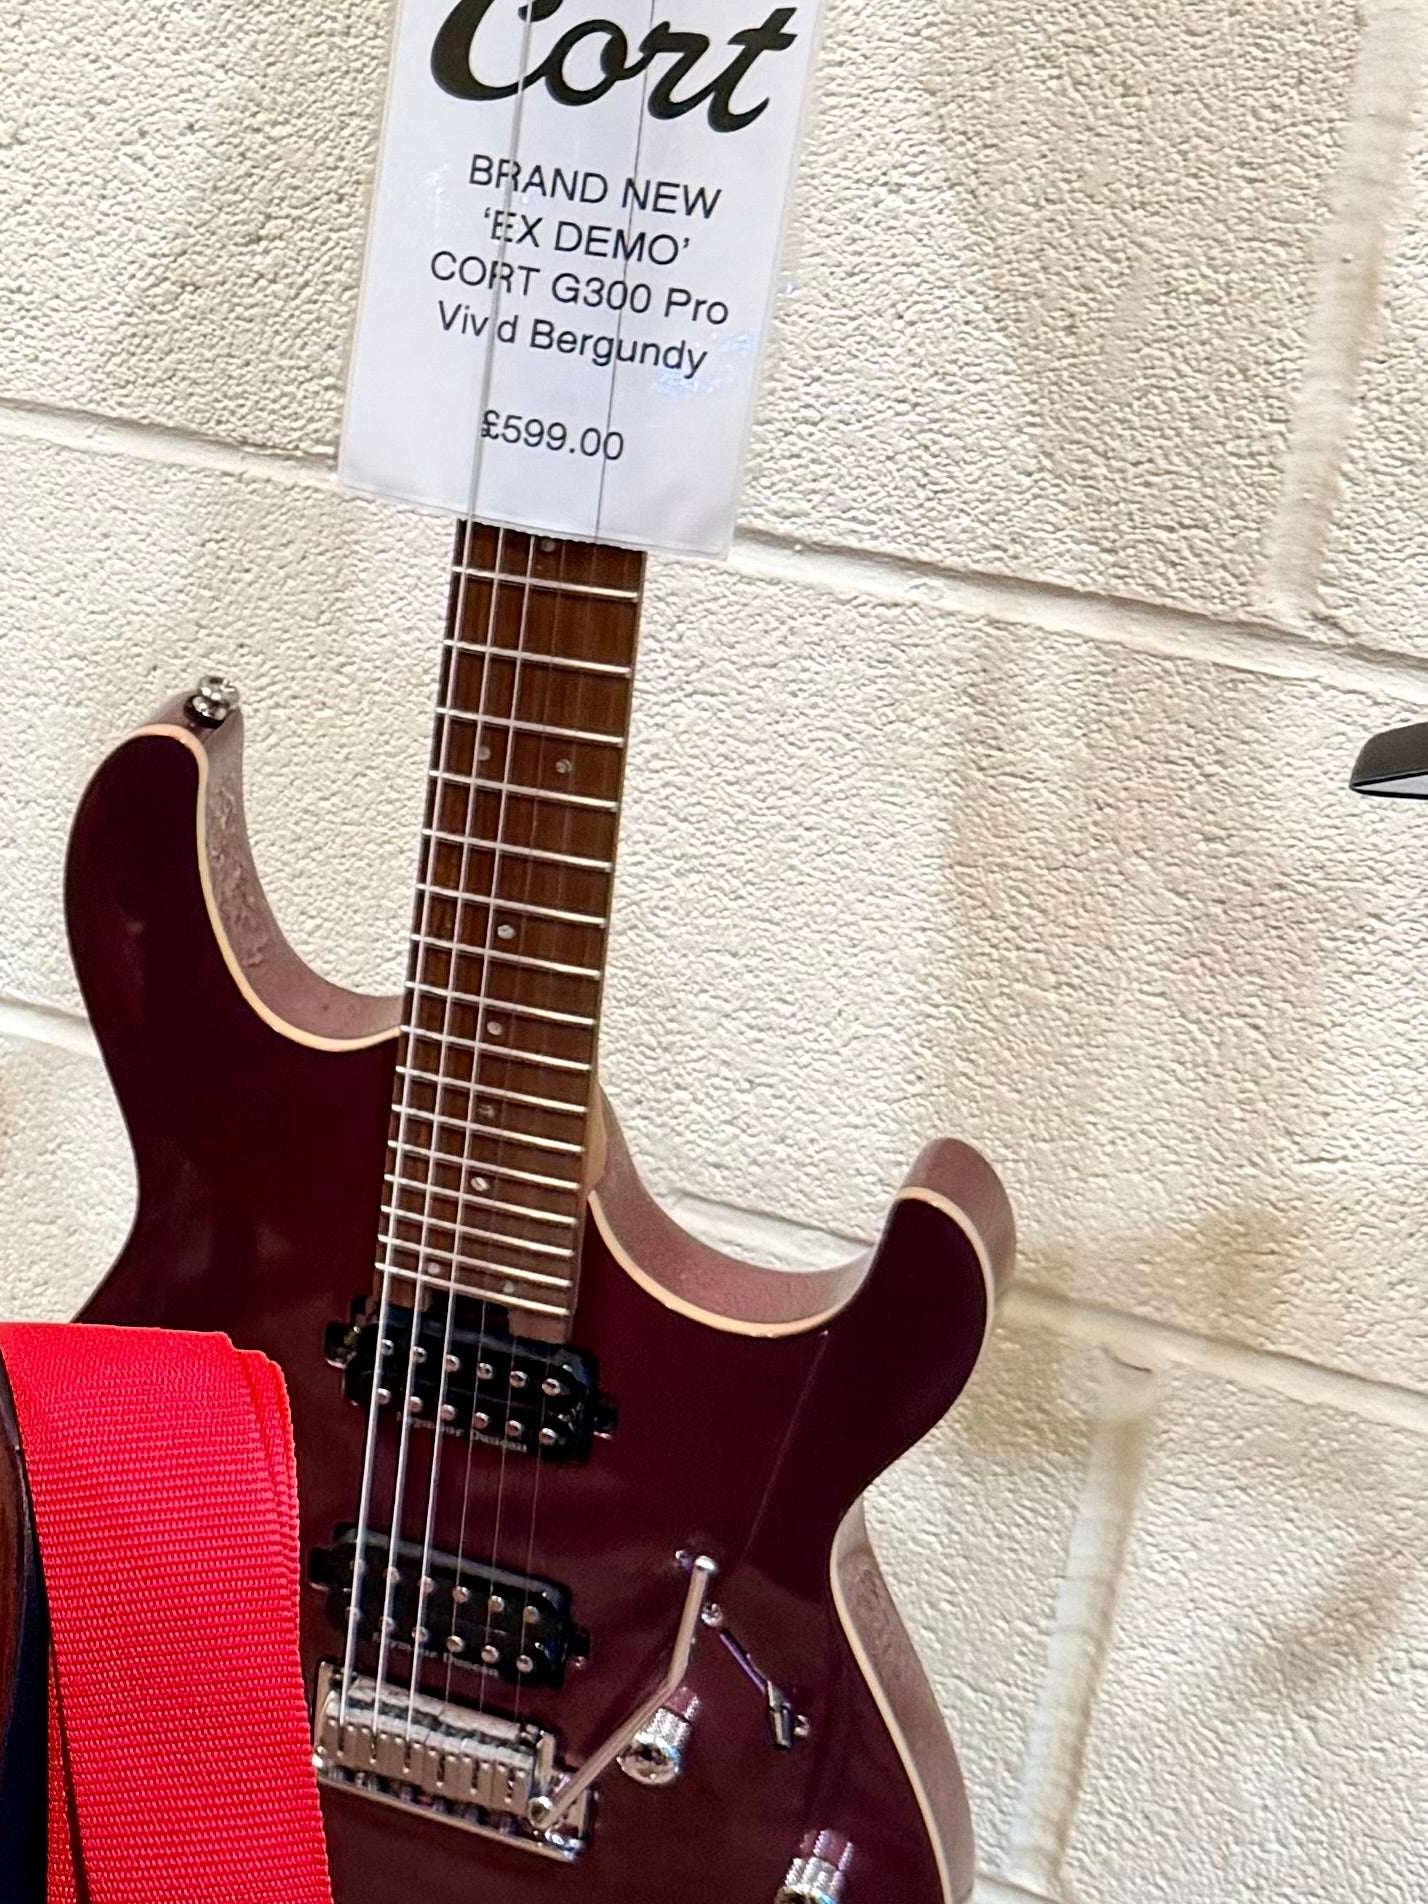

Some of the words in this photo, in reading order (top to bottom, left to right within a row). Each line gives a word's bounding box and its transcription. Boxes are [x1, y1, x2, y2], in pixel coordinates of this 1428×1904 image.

[469, 154, 608, 205] BRAND
[622, 177, 722, 220] NEW
[430, 250, 540, 297] CORT
[551, 273, 652, 315] G300
[665, 290, 730, 326] Pro
[438, 300, 519, 344] Vivd
[530, 320, 708, 380] Bergundy
[480, 409, 626, 463] £599.00
